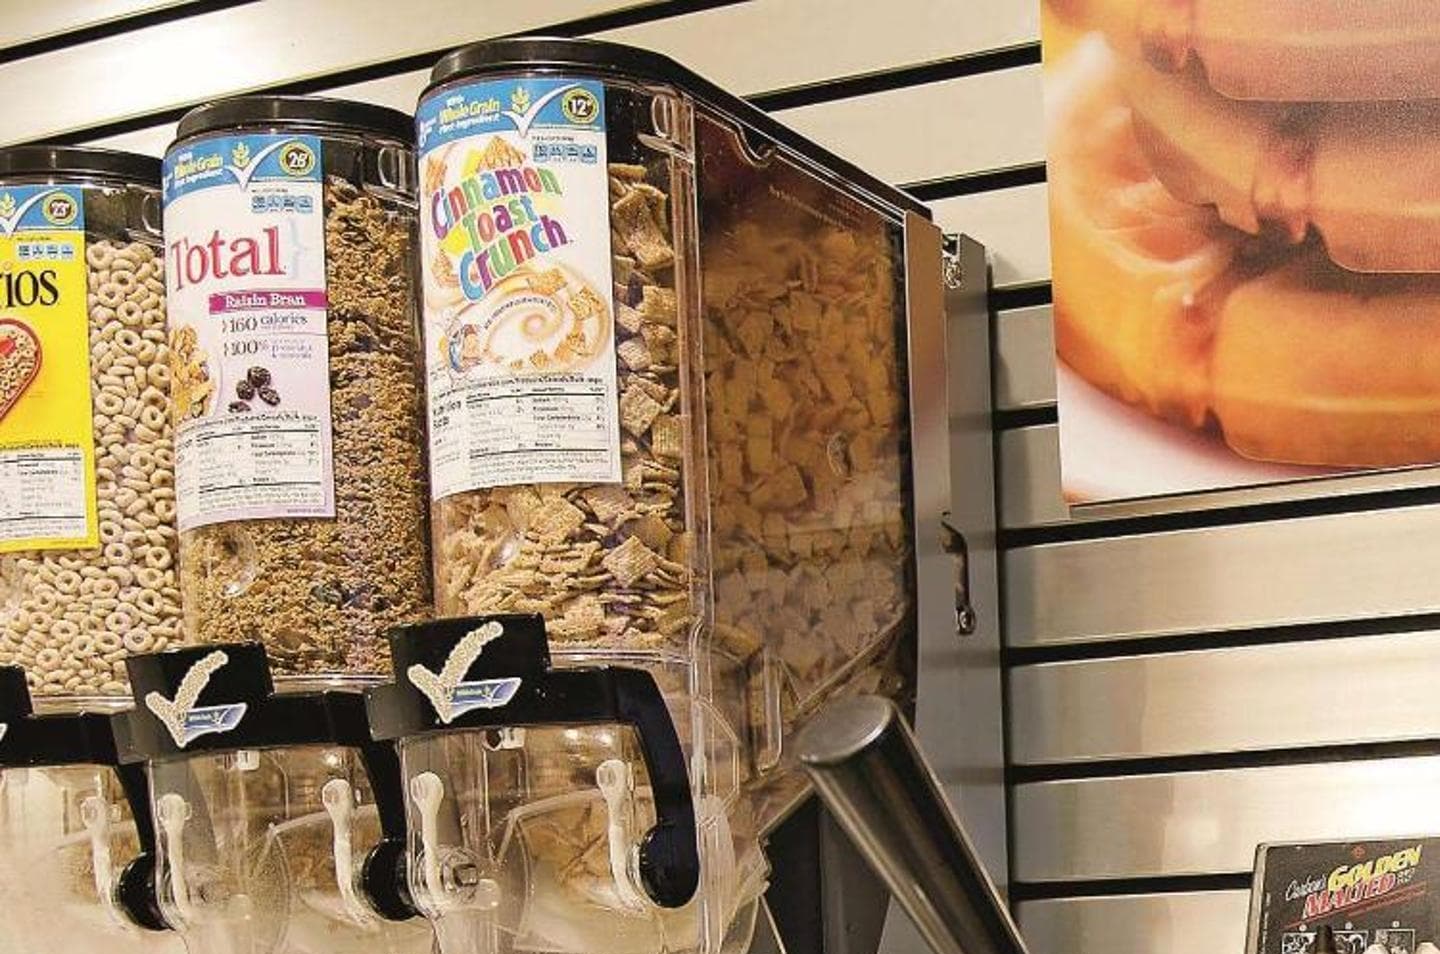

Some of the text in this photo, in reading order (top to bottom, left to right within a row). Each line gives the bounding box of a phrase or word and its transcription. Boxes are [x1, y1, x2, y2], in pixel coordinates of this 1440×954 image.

[431, 167, 564, 240] Cinnamon
[461, 196, 540, 252] Toast
[171, 226, 286, 292] Total
[459, 214, 568, 301] Crunch
[0, 262, 60, 308] ios
[224, 292, 306, 308] Raisin Bran
[229, 312, 308, 333] 160 calories
[1327, 844, 1423, 891] GOLDEN
[1302, 873, 1397, 919] MALTED
